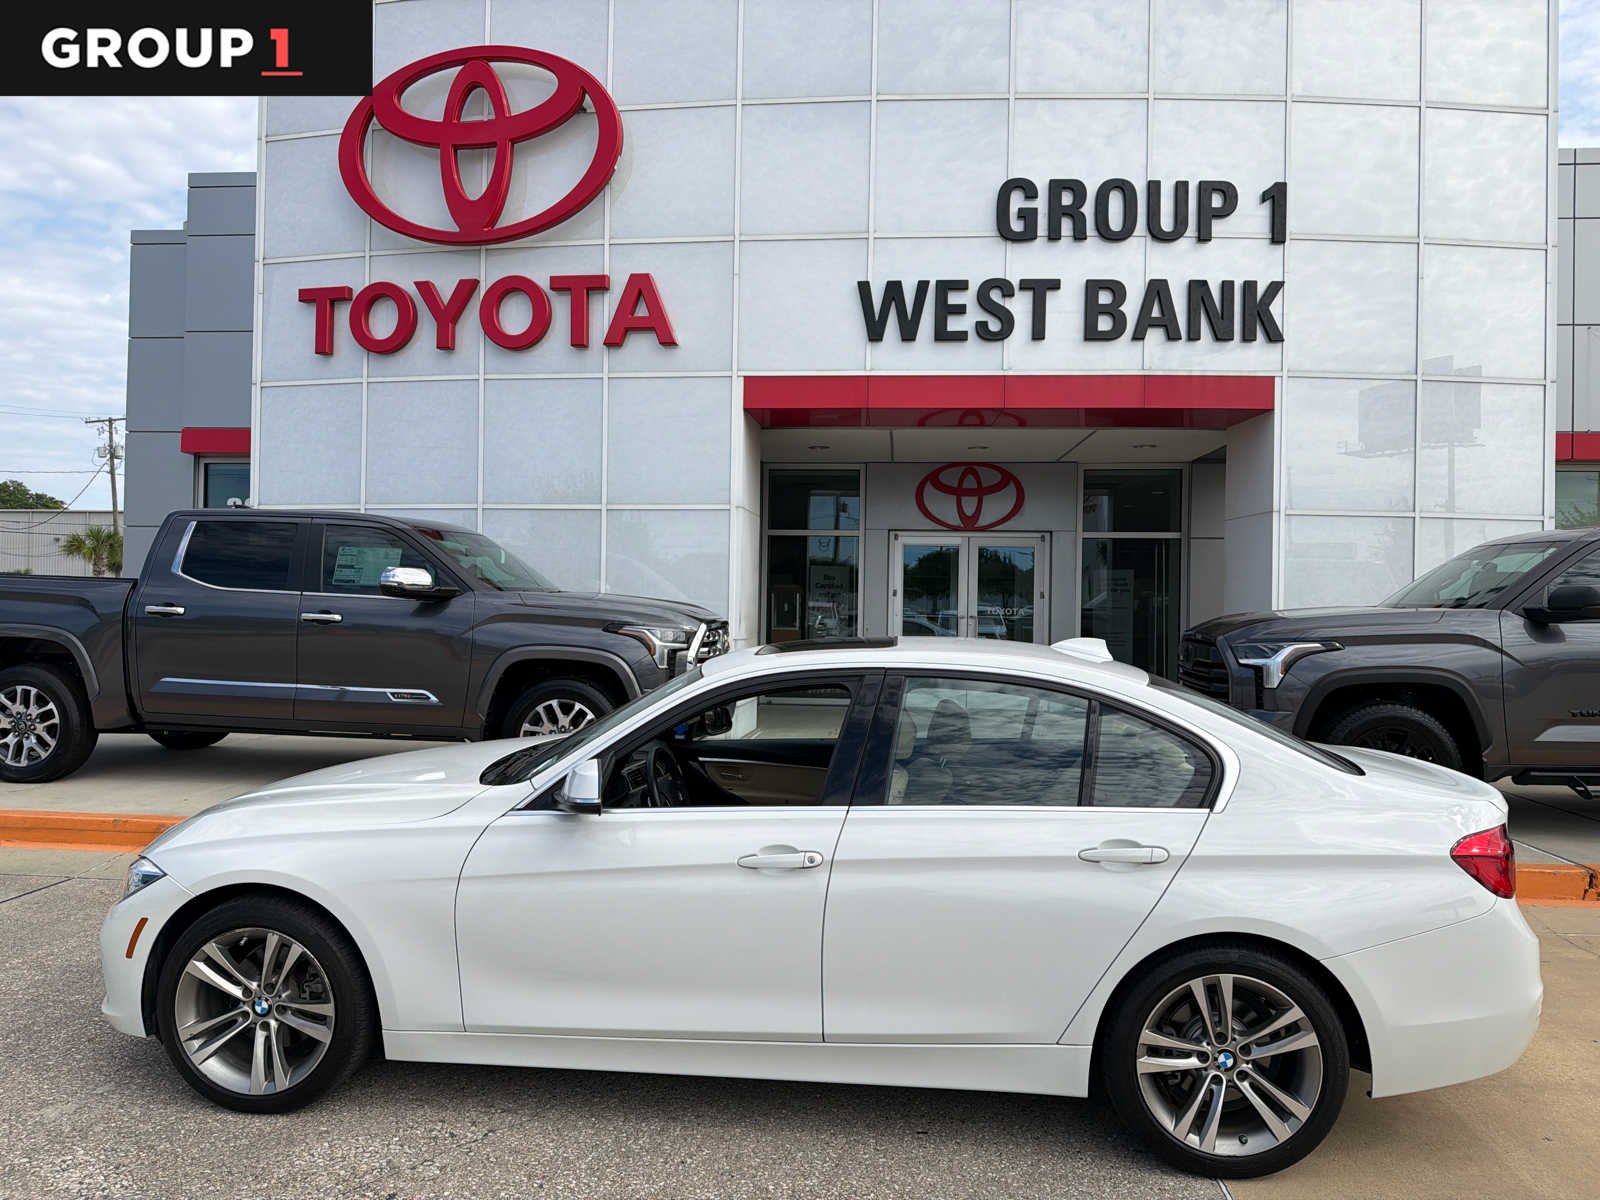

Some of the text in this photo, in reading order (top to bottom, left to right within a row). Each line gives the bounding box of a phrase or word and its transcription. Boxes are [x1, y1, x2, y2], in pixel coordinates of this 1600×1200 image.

[996, 177, 1288, 245] GROUP 1
[298, 273, 679, 356] TOYOTA
[857, 278, 1286, 343] WEST BANK
[987, 608, 1025, 617] TOYOTA
